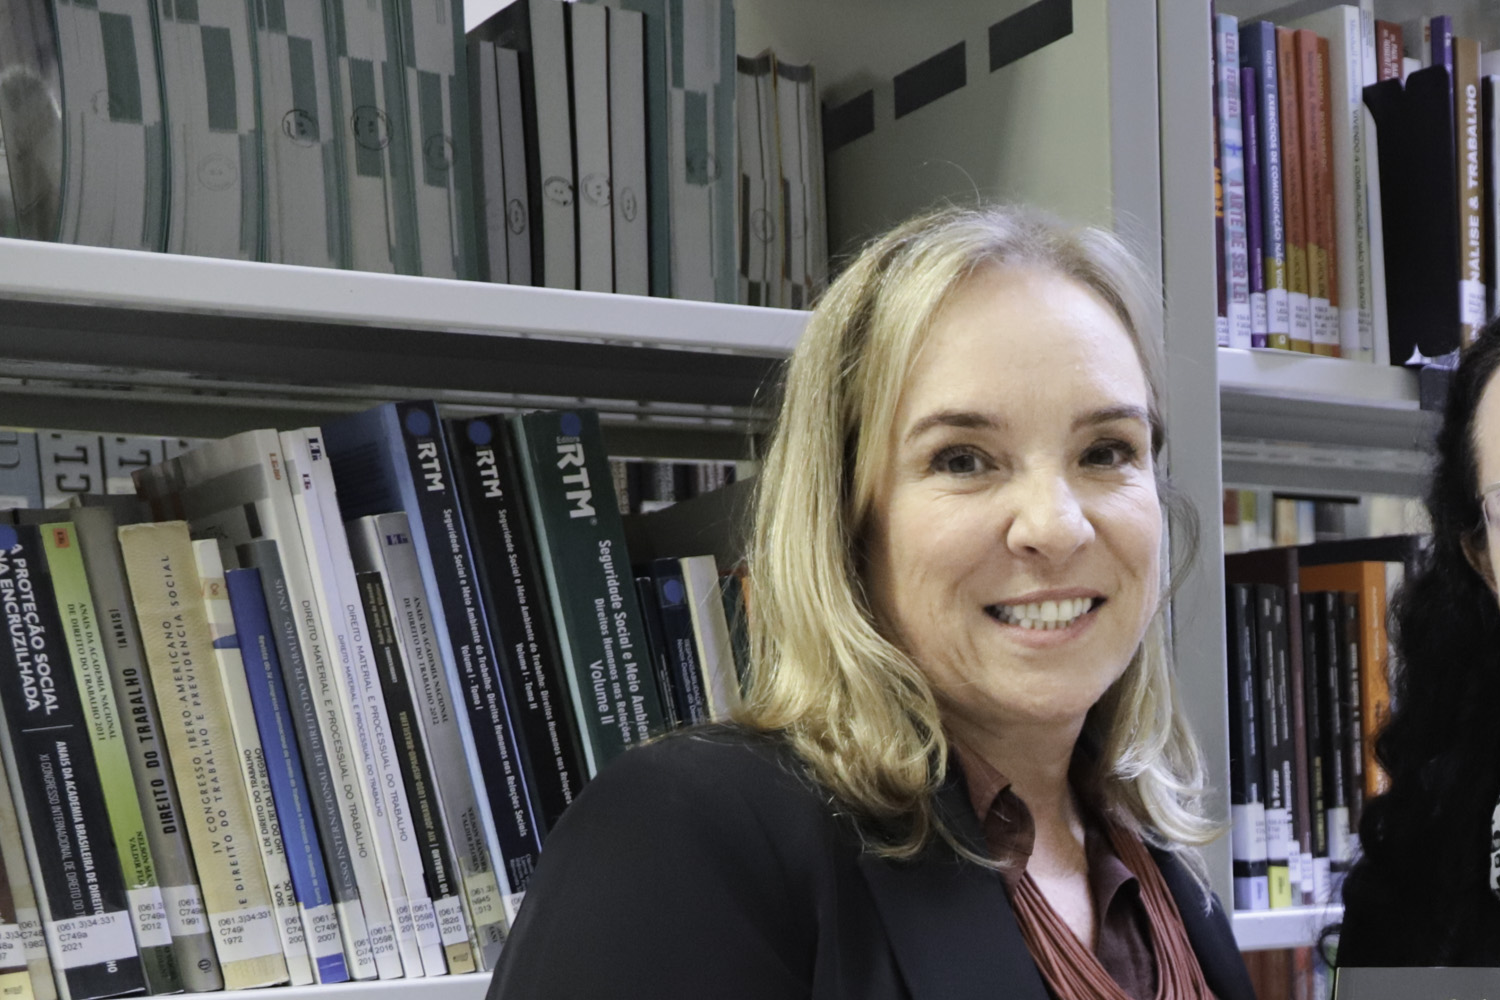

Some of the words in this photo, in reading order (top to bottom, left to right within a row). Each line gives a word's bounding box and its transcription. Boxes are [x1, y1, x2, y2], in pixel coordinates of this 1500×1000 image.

[1266, 93, 1279, 148] EXERCÍCIOS
[1350, 109, 1361, 152] VIVENDO
[1464, 83, 1479, 188] TRABALHO
[1269, 150, 1278, 163] DE
[1227, 191, 1245, 225] ARTE
[1269, 164, 1284, 240] COMUNICAÇÃO
[1352, 164, 1366, 239] COMUNICAÇÃO
[1467, 195, 1479, 210] &
[1229, 229, 1245, 247] DE
[1273, 242, 1284, 265] NÃO
[1356, 240, 1366, 262] NÃO
[1229, 251, 1246, 278] SER
[415, 440, 445, 492] RTM
[474, 447, 502, 499] RTM
[553, 441, 595, 520] RTM
[439, 508, 461, 553] Seguridade
[494, 508, 514, 553] Seguridade
[452, 553, 466, 578] Social
[506, 552, 520, 577] Social
[596, 539, 624, 609] Seguridade
[459, 585, 473, 605] Meio
[513, 585, 526, 604] Meio
[78, 601, 91, 629] ANAIS
[301, 599, 318, 641] DIREITO
[346, 603, 362, 642] DIREITO
[464, 605, 482, 643] Ambiente
[518, 604, 535, 641] Ambiente
[593, 597, 610, 635] Direitos
[613, 610, 633, 648] Social
[9, 556, 45, 651] PROTEÇÃO
[33, 652, 59, 715] SOCIAL
[85, 631, 94, 644] DA
[473, 643, 484, 654] do
[527, 642, 537, 653] do
[88, 645, 105, 692] ACADEMIA
[311, 643, 330, 695] MATERIAL
[355, 644, 373, 691] MATERIAL
[514, 642, 529, 671] Volume
[529, 653, 546, 689] Trabalho:
[602, 636, 620, 680] Humanos
[622, 651, 631, 660] e
[476, 655, 494, 692] Trabalho:
[524, 681, 536, 699] Tomo
[611, 681, 621, 699] nas
[624, 661, 641, 691] Meio
[123, 665, 154, 743] TRABALHO
[485, 691, 501, 723] Direitos
[529, 699, 539, 709] II
[538, 689, 553, 720] Direitos
[587, 659, 613, 713] Volume
[601, 714, 614, 724] II
[99, 693, 117, 740] NACIONAL
[614, 700, 633, 742] Relações
[631, 693, 652, 740] Ambien
[326, 709, 349, 781] PROCESSUAL
[369, 704, 391, 770] PROCESSUAL
[493, 723, 509, 758] Humanos
[545, 720, 561, 755] Humanos
[143, 749, 160, 769] DO
[501, 758, 511, 774] nas
[554, 756, 563, 770] nas
[342, 782, 354, 800] DO
[385, 772, 396, 789] DO
[504, 774, 522, 809] Relações
[556, 771, 573, 805] Relações
[150, 777, 177, 835] DIREITO
[388, 789, 408, 841] TRABALHO
[513, 808, 528, 837] Sociais
[347, 803, 367, 859] TRABALHO
[61, 942, 83, 952] 2021
